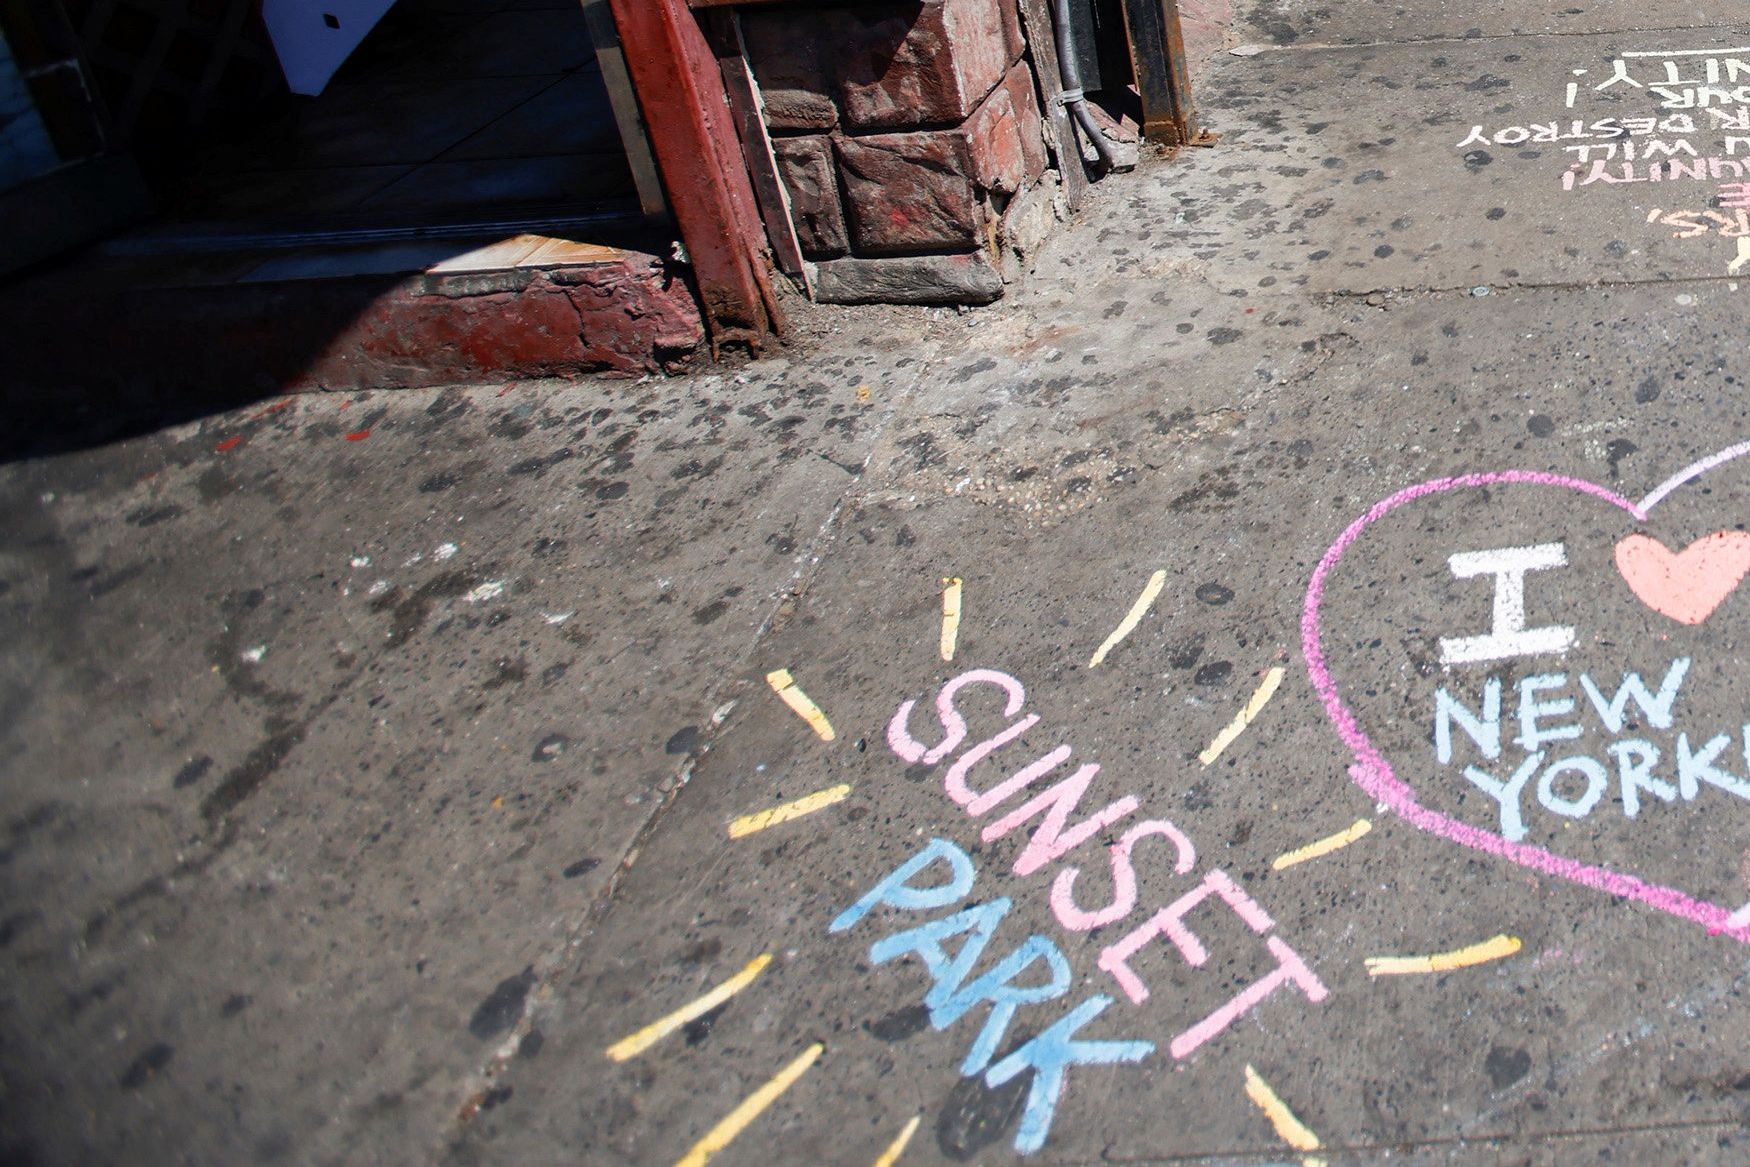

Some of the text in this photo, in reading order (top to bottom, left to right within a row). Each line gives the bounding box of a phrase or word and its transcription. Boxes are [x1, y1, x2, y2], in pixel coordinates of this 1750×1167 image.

[1455, 113, 1698, 149] DESTROY
[1560, 137, 1698, 162] WILL
[1438, 541, 1578, 666] I
[1432, 656, 1692, 764] NEW
[886, 667, 1332, 1060] SUNSET
[827, 835, 1157, 1156] PARK
